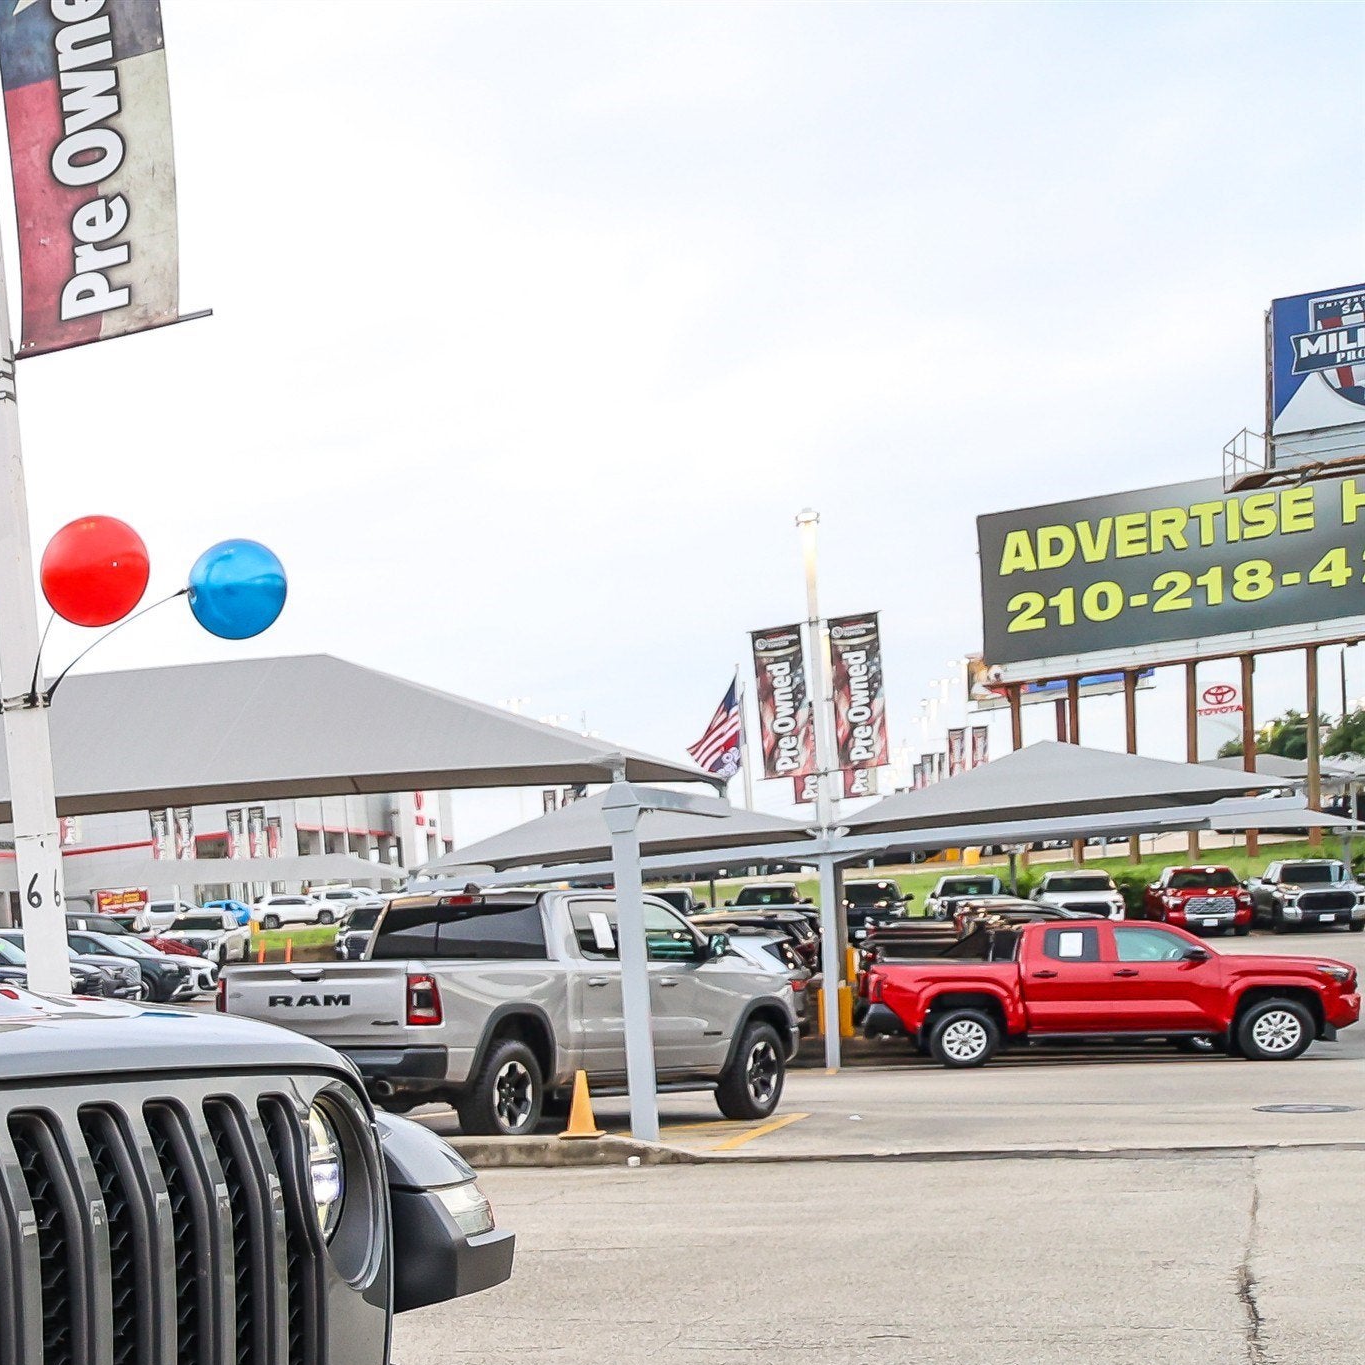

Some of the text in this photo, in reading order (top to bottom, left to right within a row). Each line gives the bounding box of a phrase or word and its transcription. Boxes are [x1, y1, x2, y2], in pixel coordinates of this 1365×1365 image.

[61, 195, 131, 321] Pre
[999, 486, 1315, 576] ADVERTISE
[1006, 547, 1365, 634] 210-218-4
[766, 661, 798, 734] Owned
[842, 649, 872, 724] Owned
[775, 735, 799, 772] Pre
[849, 725, 875, 762] Pre
[27, 872, 43, 909] 6
[269, 994, 351, 1007] RAM
